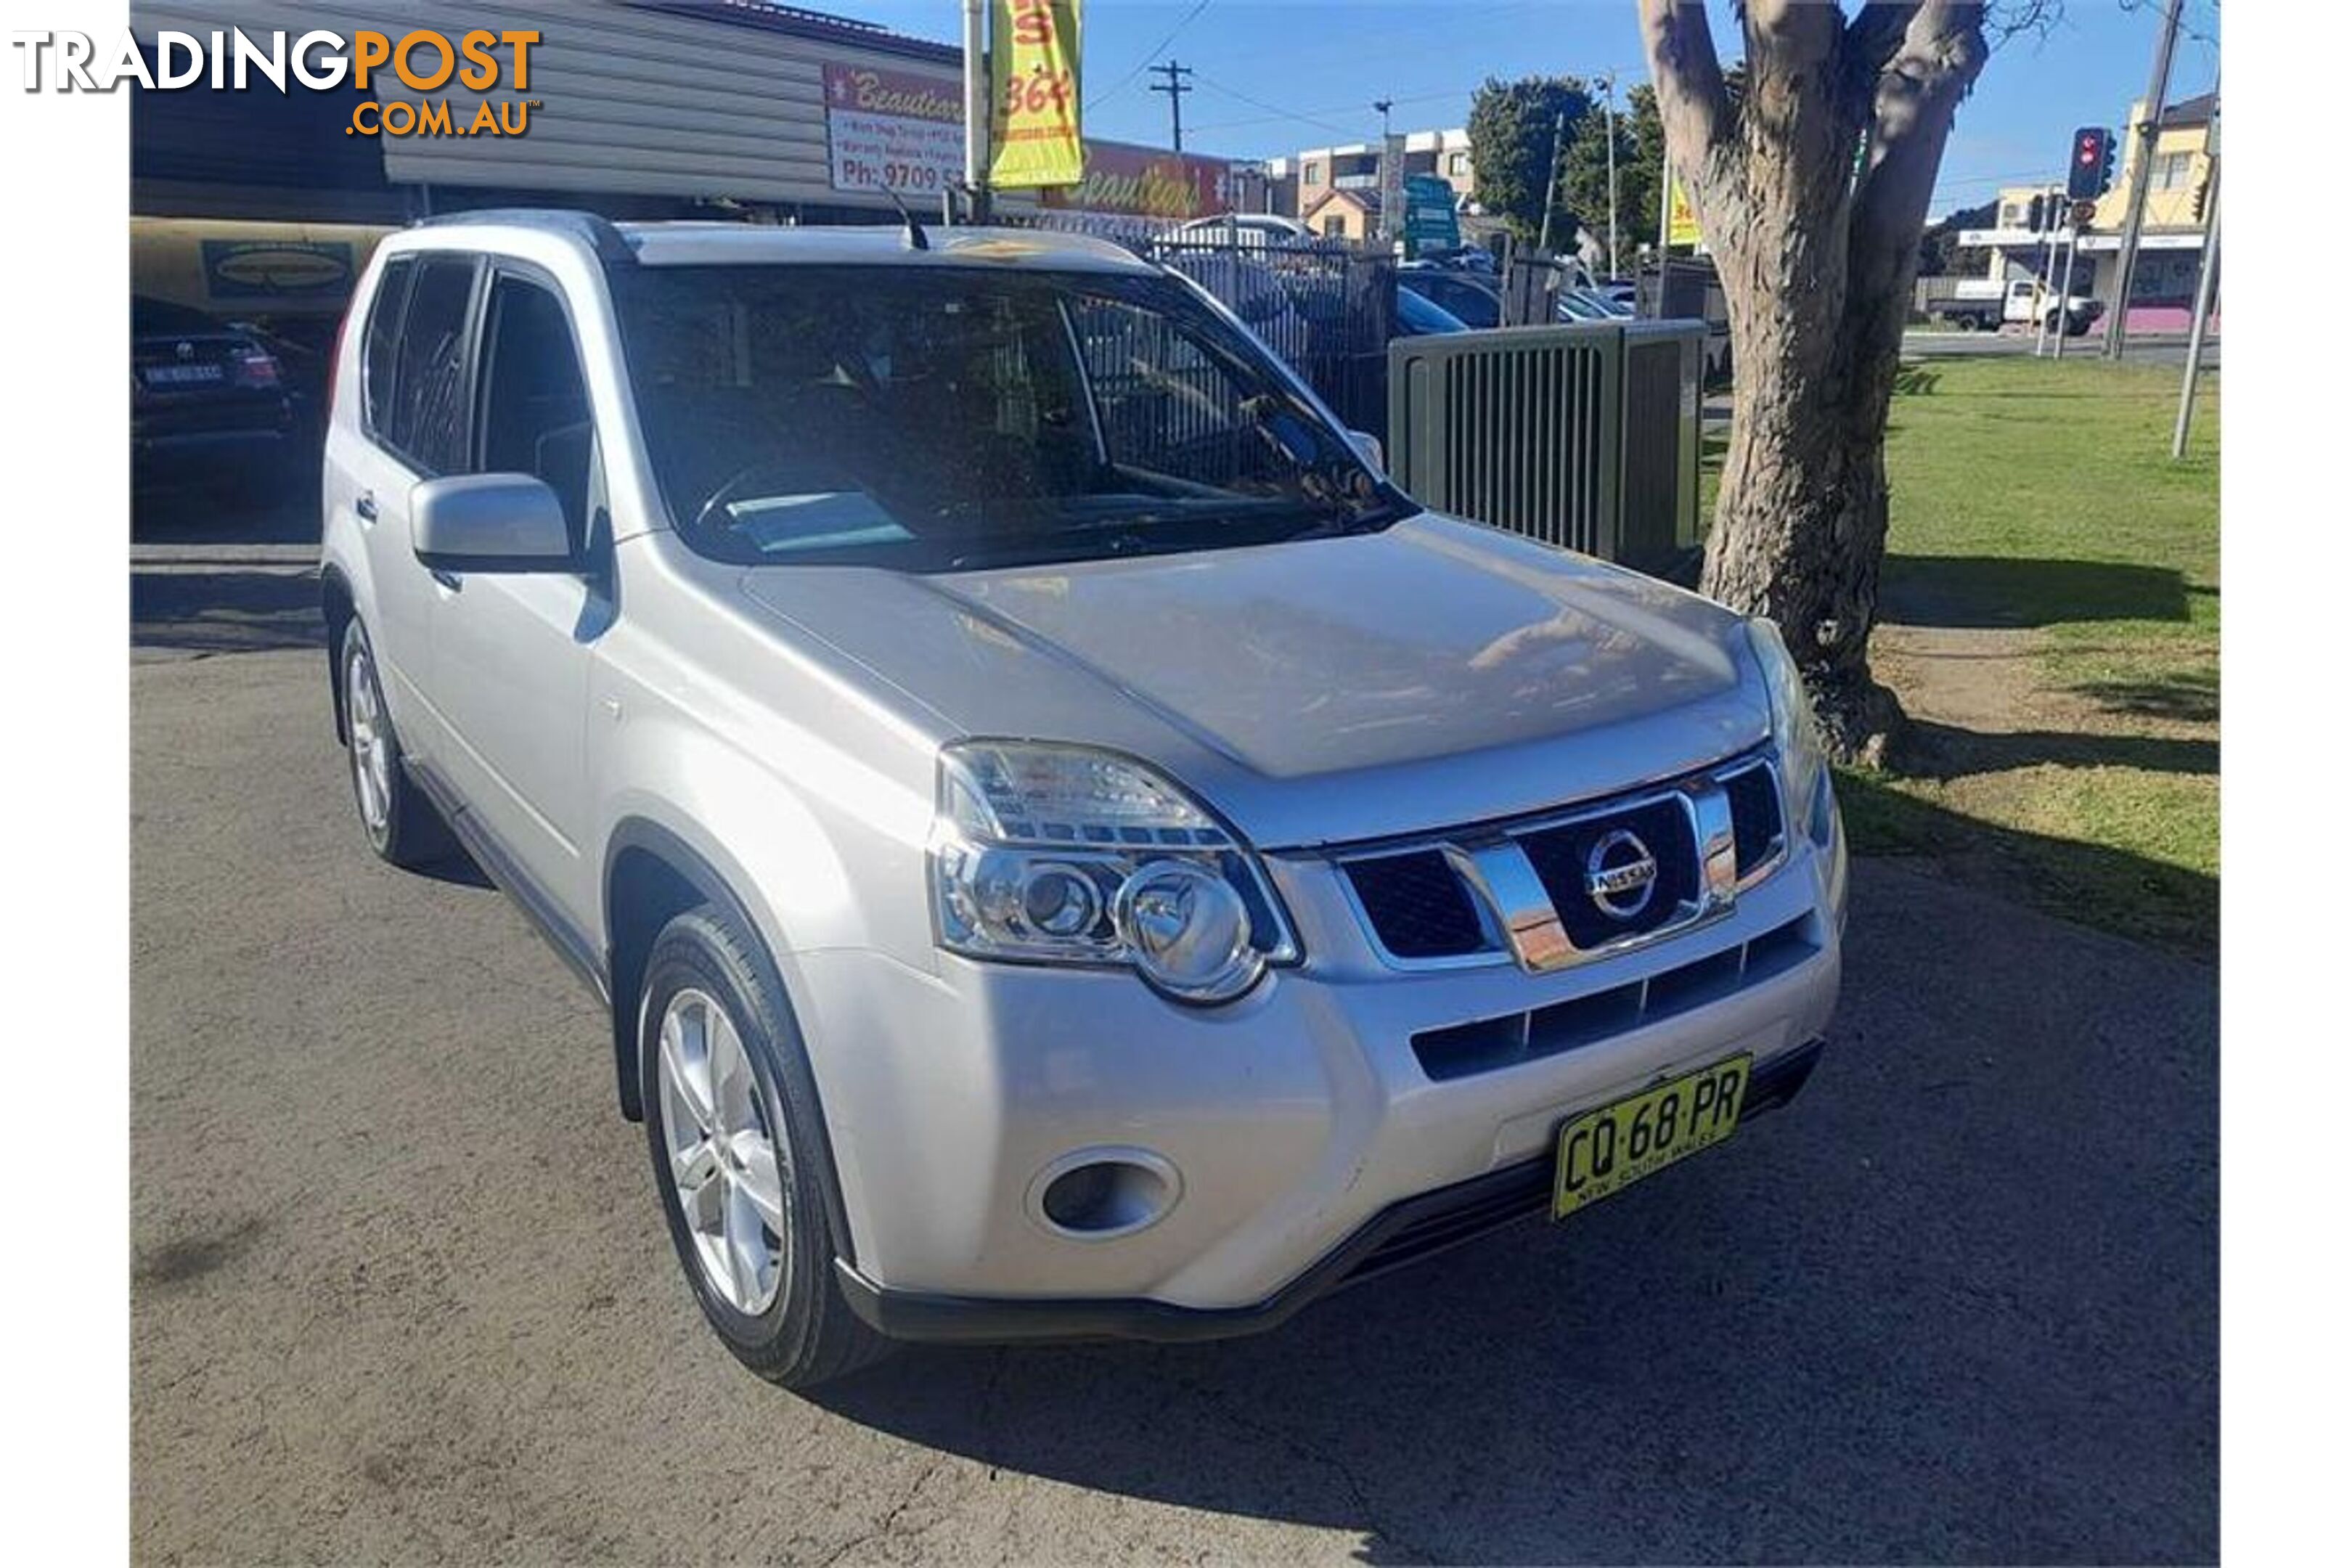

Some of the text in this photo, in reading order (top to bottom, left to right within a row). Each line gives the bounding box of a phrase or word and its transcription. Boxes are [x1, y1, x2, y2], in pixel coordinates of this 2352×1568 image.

[843, 159, 879, 184] Ph:
[885, 163, 937, 189] 9709
[1592, 862, 1656, 893] NISSAN
